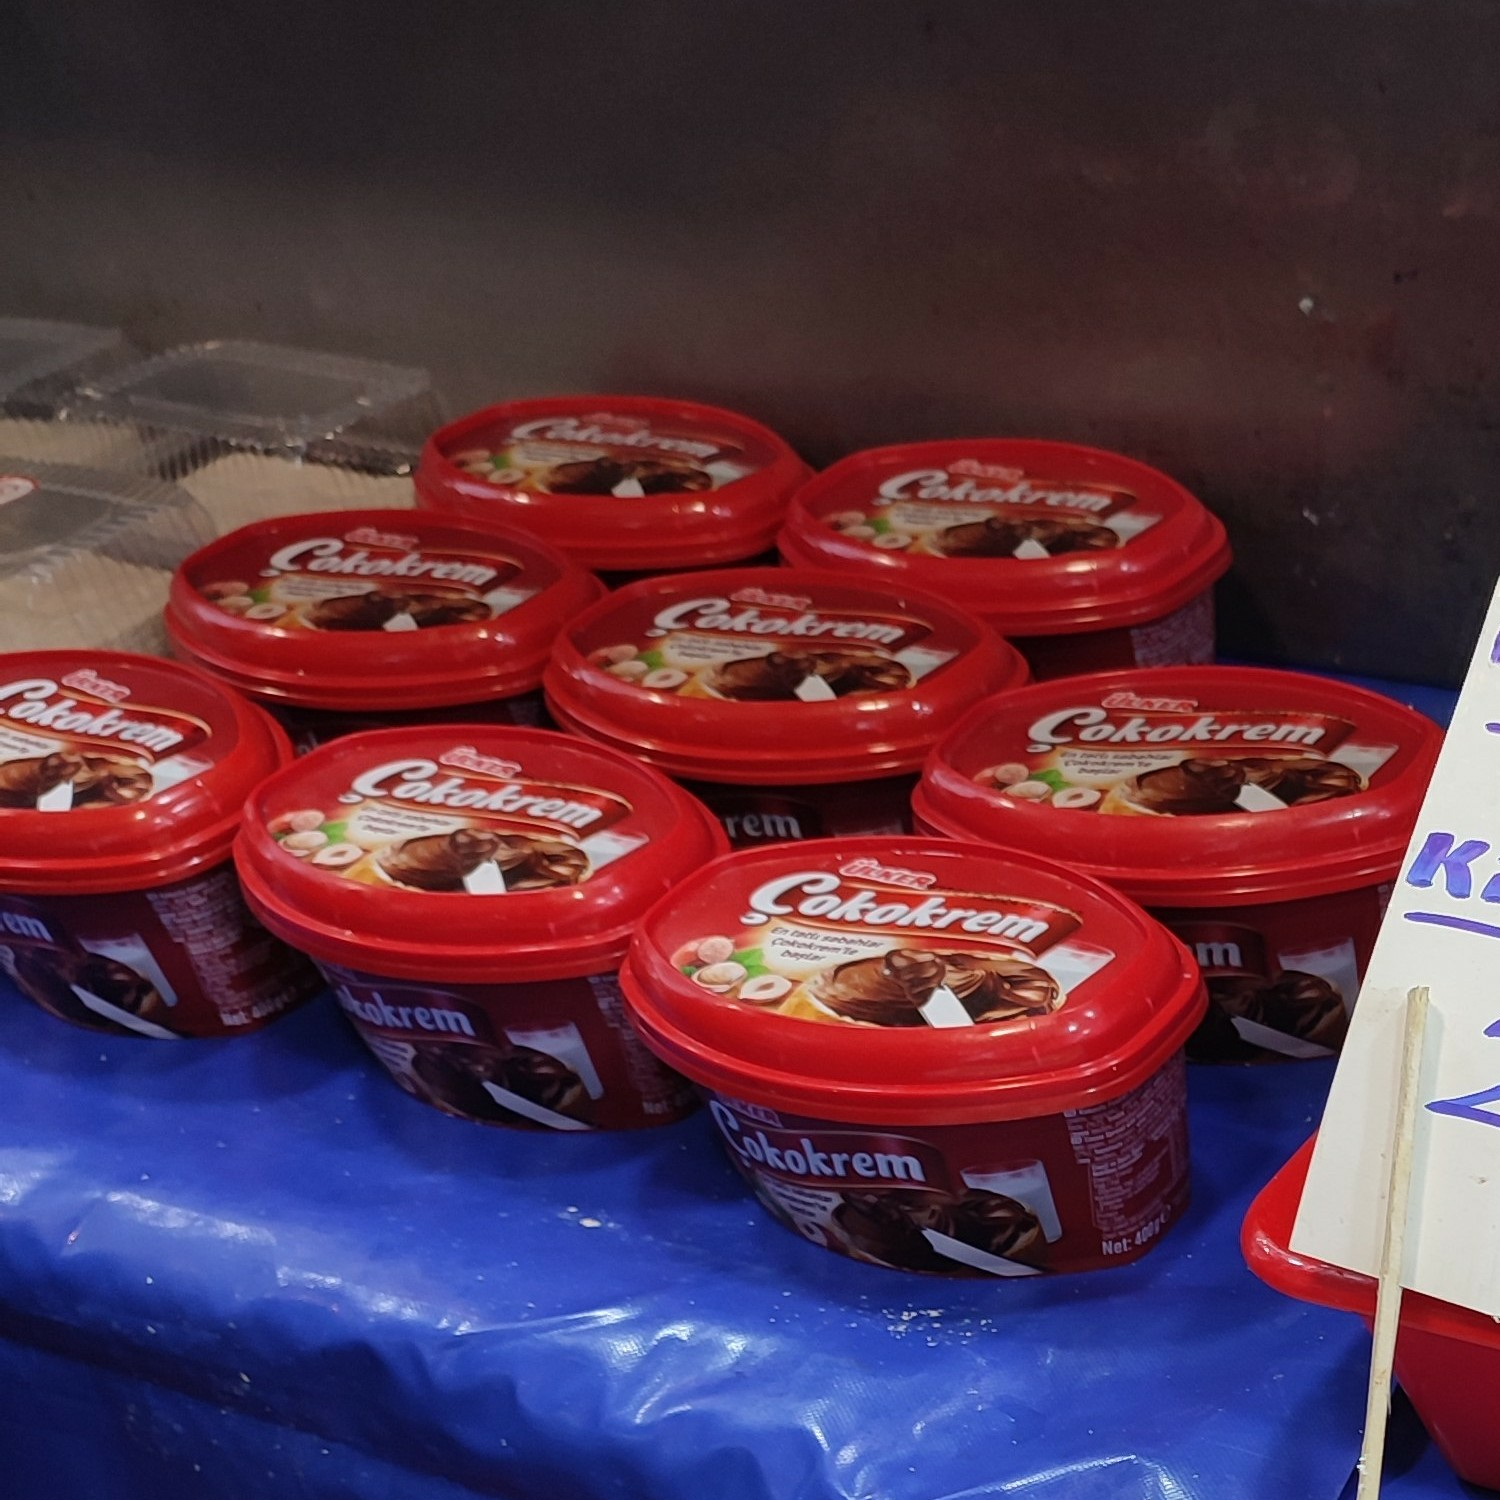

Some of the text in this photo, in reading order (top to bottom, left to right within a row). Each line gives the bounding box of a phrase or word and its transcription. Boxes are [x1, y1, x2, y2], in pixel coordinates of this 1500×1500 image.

[1026, 707, 1326, 753] Çokokrem
[338, 759, 602, 829] Çokokrem
[842, 859, 936, 889] ÜLKER
[740, 871, 1049, 943] Çokokrem
